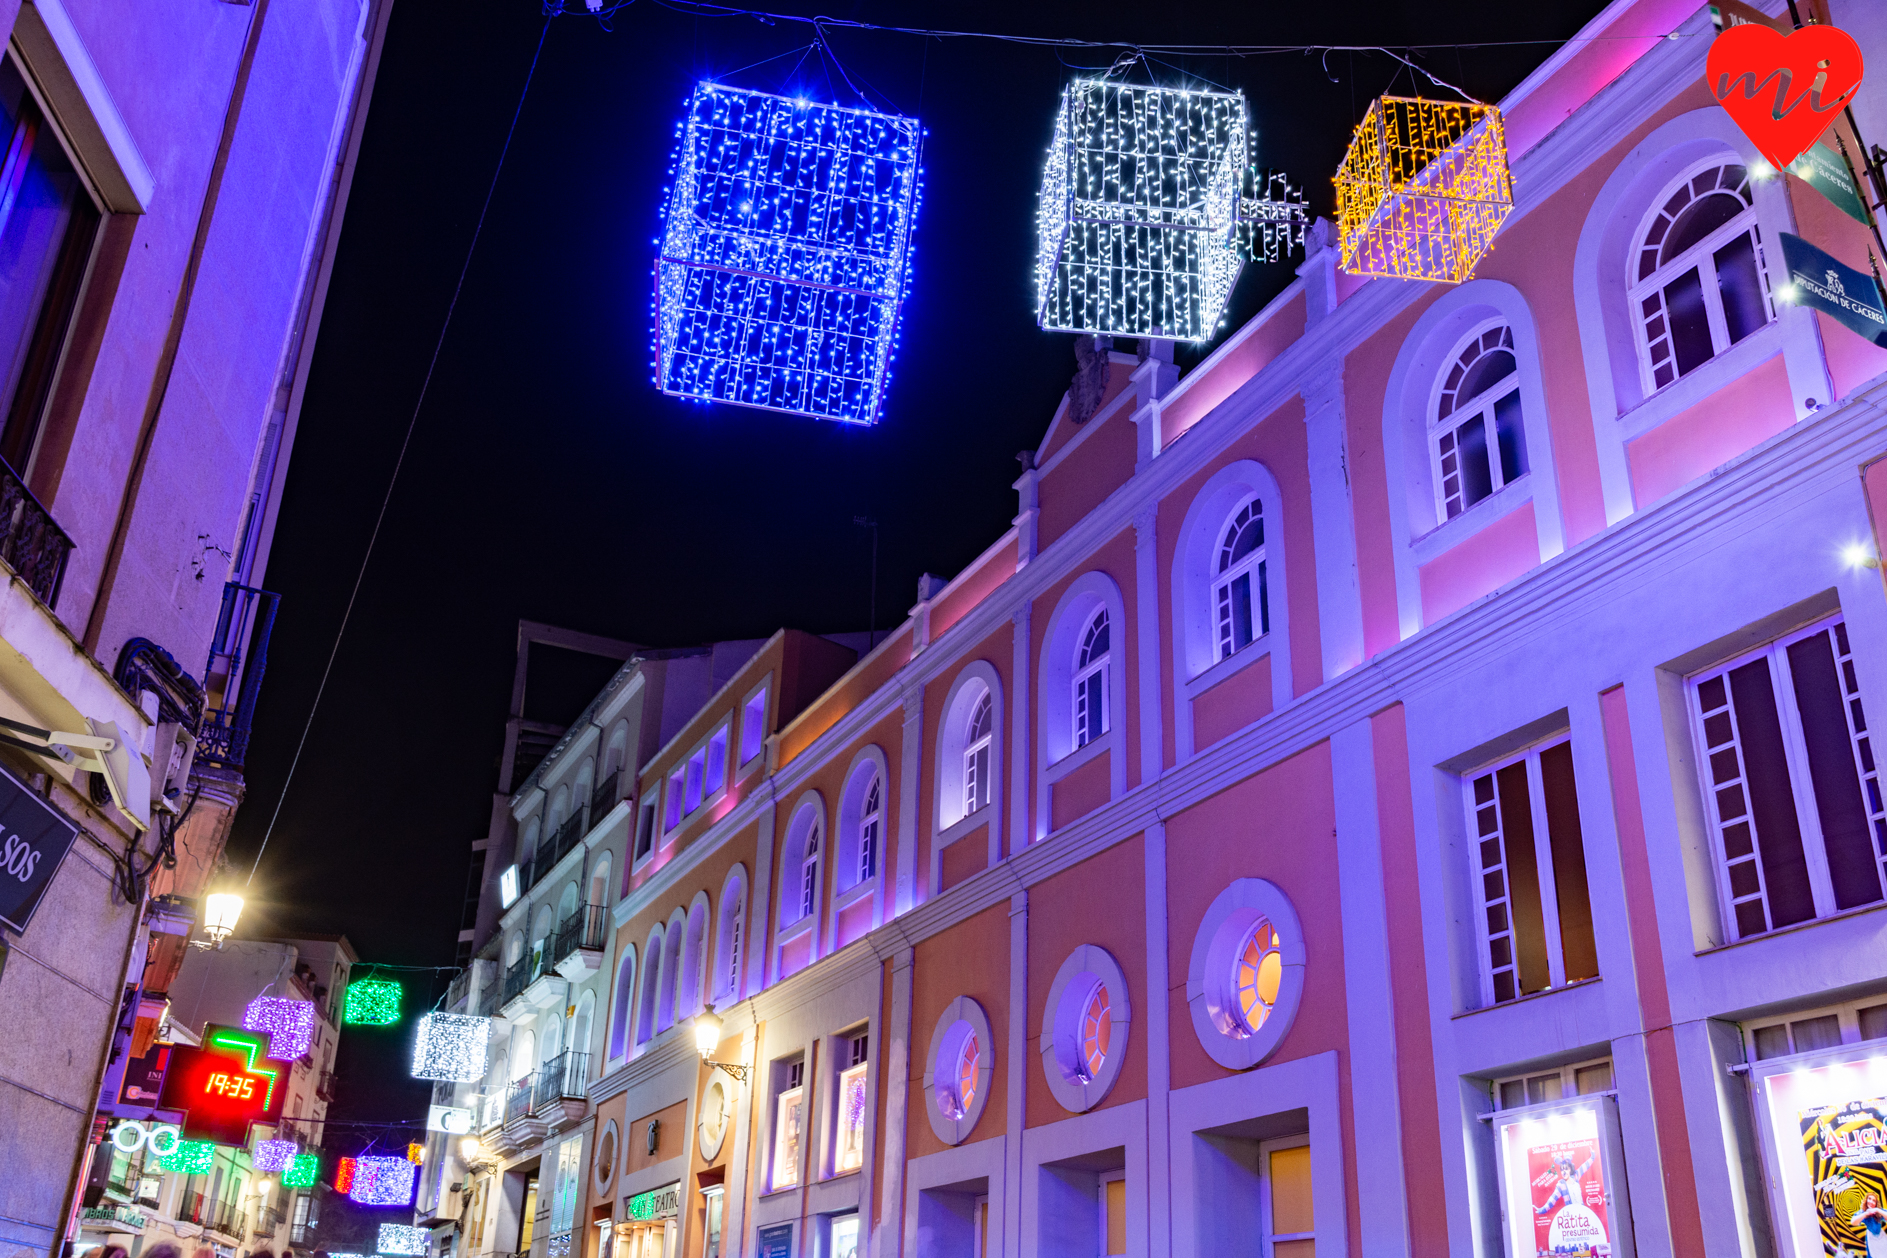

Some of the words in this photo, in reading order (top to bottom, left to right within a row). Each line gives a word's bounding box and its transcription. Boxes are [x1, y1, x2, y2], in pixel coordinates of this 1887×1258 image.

[1810, 159, 1853, 194] Cáceres
[1793, 274, 1839, 304] DIPUTACIÓN
[1840, 297, 1851, 309] DE
[1851, 303, 1885, 325] CÁCERES
[0, 824, 41, 882] SOS
[206, 1073, 254, 1098] 19:35
[1557, 1214, 1590, 1230] Ratita
[1562, 1226, 1600, 1241] presumida
